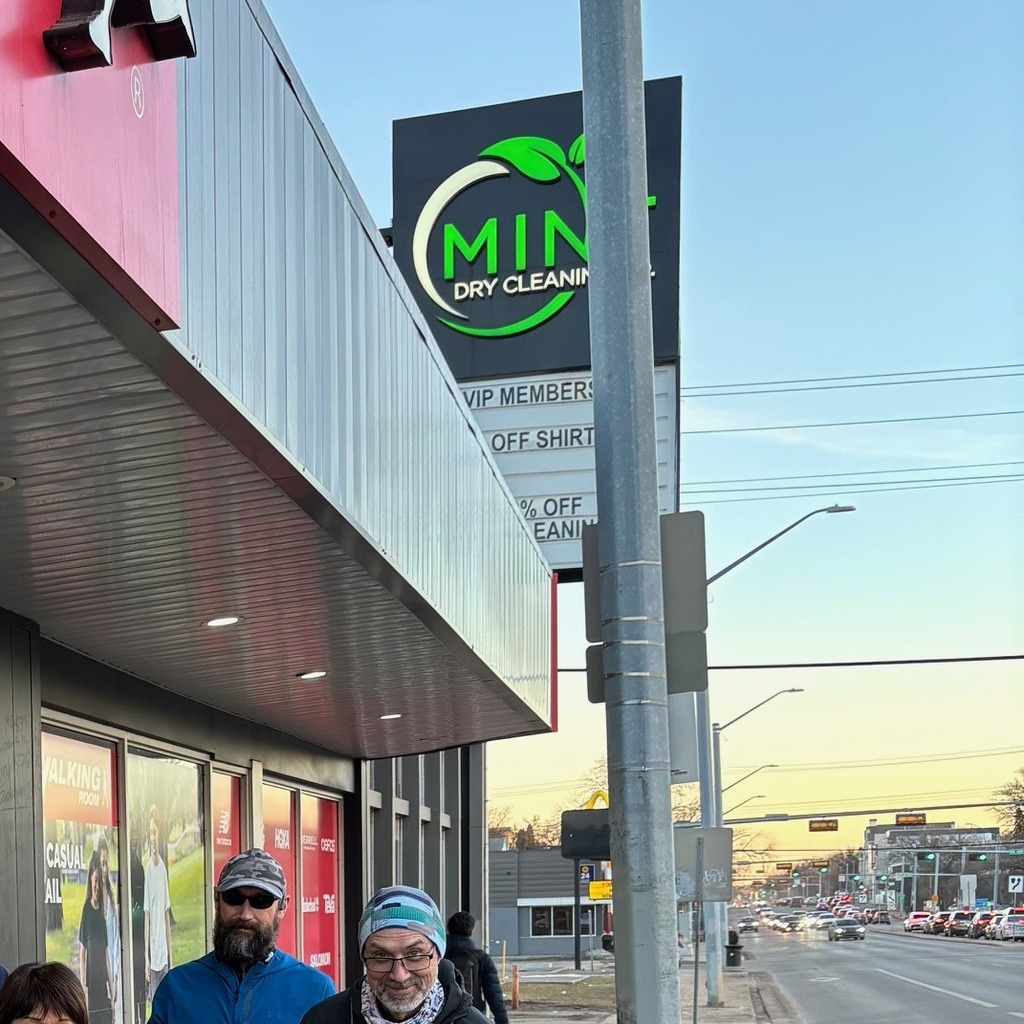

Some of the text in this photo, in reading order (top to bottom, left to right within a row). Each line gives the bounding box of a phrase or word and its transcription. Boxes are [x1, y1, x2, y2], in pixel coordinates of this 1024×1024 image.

[443, 195, 657, 281] MIN
[454, 269, 589, 301] DRY CLEANIN
[463, 389, 493, 409] VIP
[491, 431, 530, 452] OFF
[543, 497, 582, 516] OFF
[534, 519, 594, 540] EANI
[78, 791, 101, 808] ROOM
[46, 841, 86, 870] CASUAL
[44, 878, 63, 904] AIL
